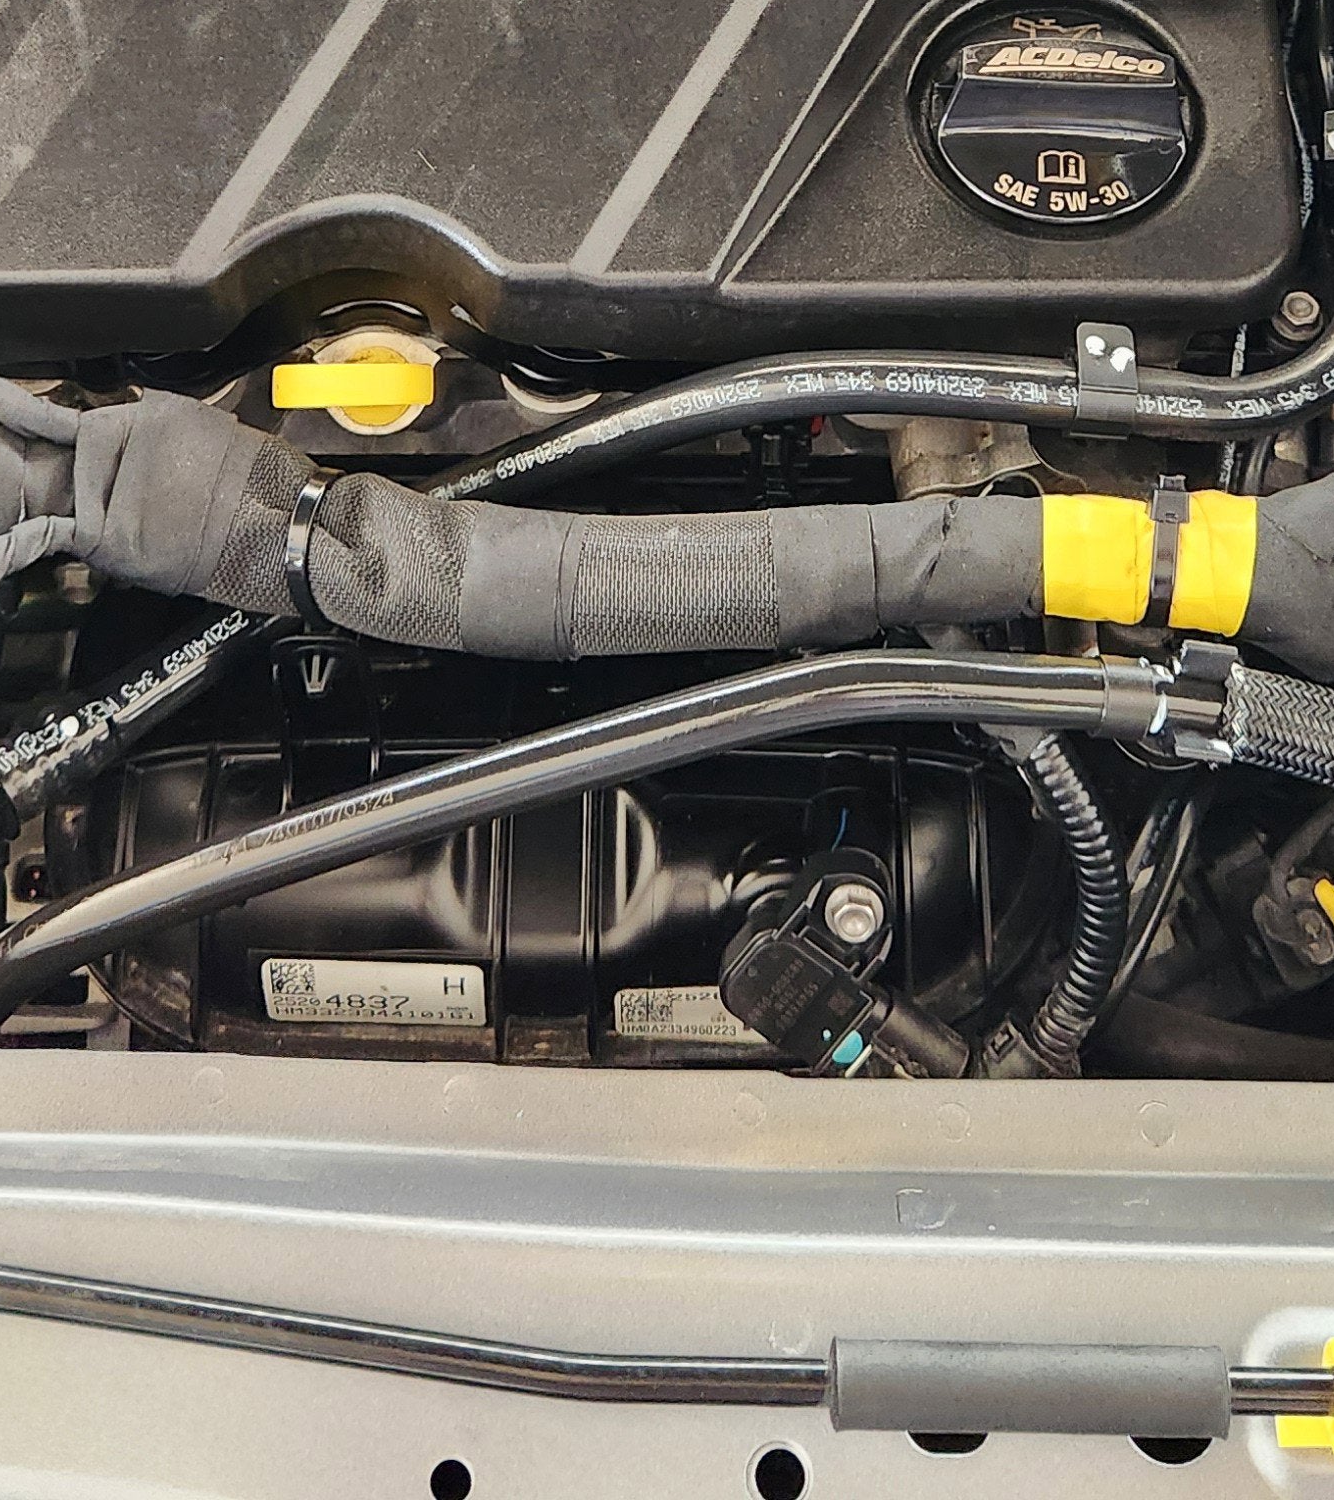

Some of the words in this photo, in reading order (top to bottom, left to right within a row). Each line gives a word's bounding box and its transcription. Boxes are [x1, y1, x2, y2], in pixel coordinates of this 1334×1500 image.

[985, 45, 1166, 76] ACDelco
[994, 173, 1040, 208] SAE
[1049, 179, 1131, 212] 5W-30
[785, 372, 826, 393] MEX
[836, 369, 876, 393] 345
[885, 371, 989, 399] 25204069
[1008, 381, 1049, 402] MEX
[670, 380, 764, 416] 25204069
[1224, 395, 1273, 420] MEX
[495, 432, 577, 482] 25204069
[442, 975, 466, 996] H
